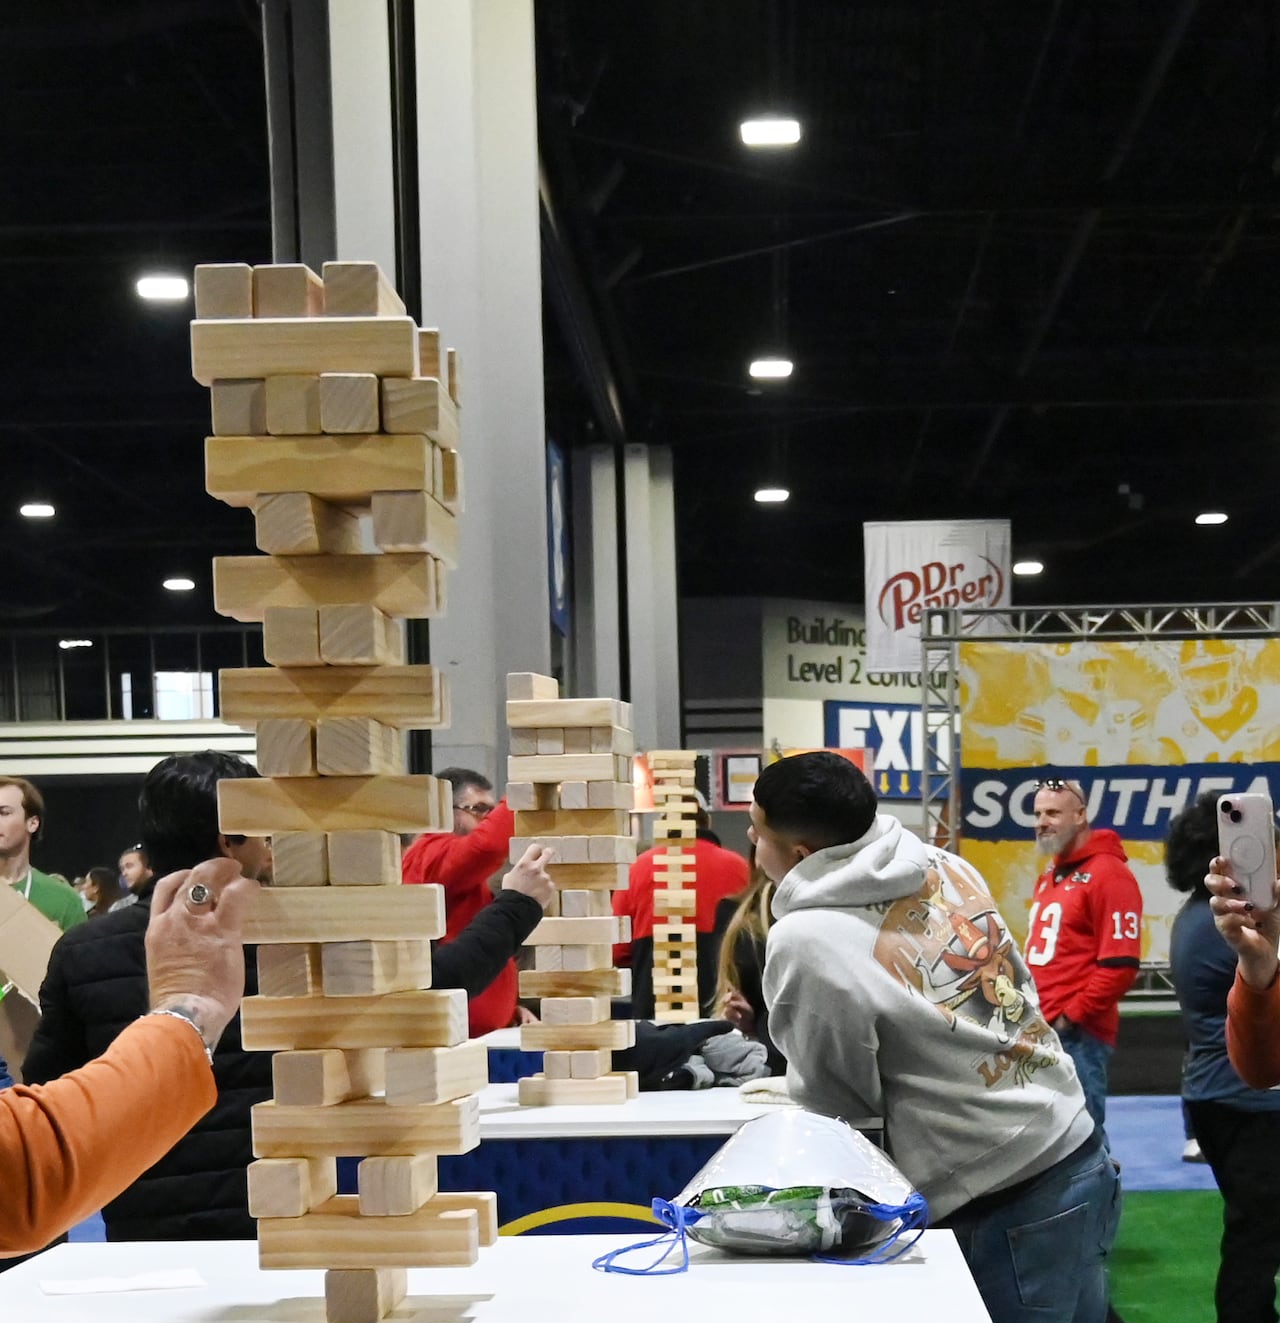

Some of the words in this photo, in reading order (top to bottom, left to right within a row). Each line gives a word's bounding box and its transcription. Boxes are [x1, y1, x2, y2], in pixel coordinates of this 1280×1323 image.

[879, 571, 993, 631] Pepper
[922, 561, 965, 597] Dr
[787, 654, 842, 684] Level
[849, 660, 861, 684] 2
[866, 671, 960, 690] Concurs
[838, 708, 962, 771] EXIT
[1023, 902, 1062, 966] 13
[1112, 910, 1139, 940] 13
